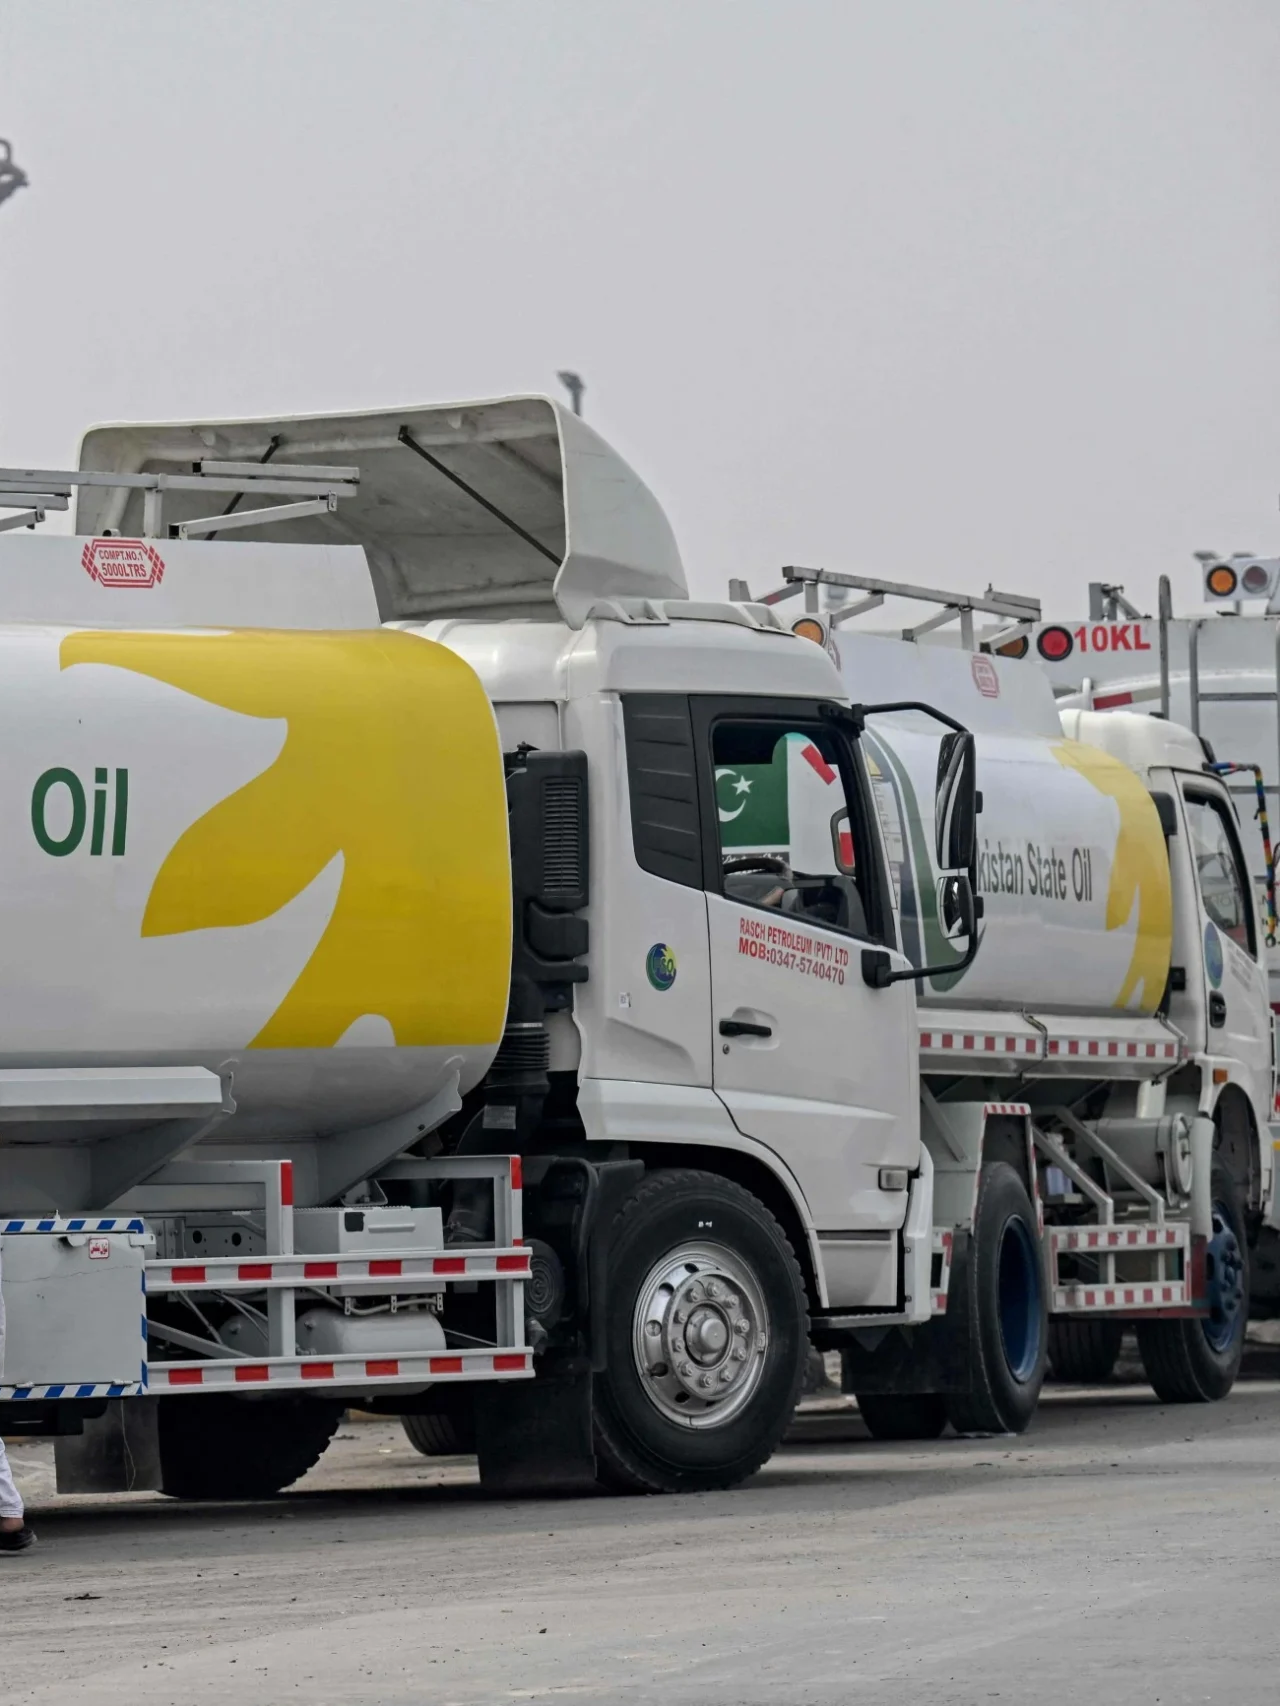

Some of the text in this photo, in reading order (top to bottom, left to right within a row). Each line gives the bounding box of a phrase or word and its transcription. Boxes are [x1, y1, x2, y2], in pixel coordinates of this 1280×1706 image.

[98, 550, 143, 560] COMPT.NO.1
[102, 562, 146, 577] 5000LTRS
[1074, 624, 1151, 652] 10KL
[31, 766, 128, 857] Oil
[1027, 842, 1066, 900] State
[1072, 848, 1092, 902] Oil
[739, 937, 844, 985] MOB:0347-5740470
[740, 918, 849, 966] RASCH PETROLEUM (PVT) LTD
